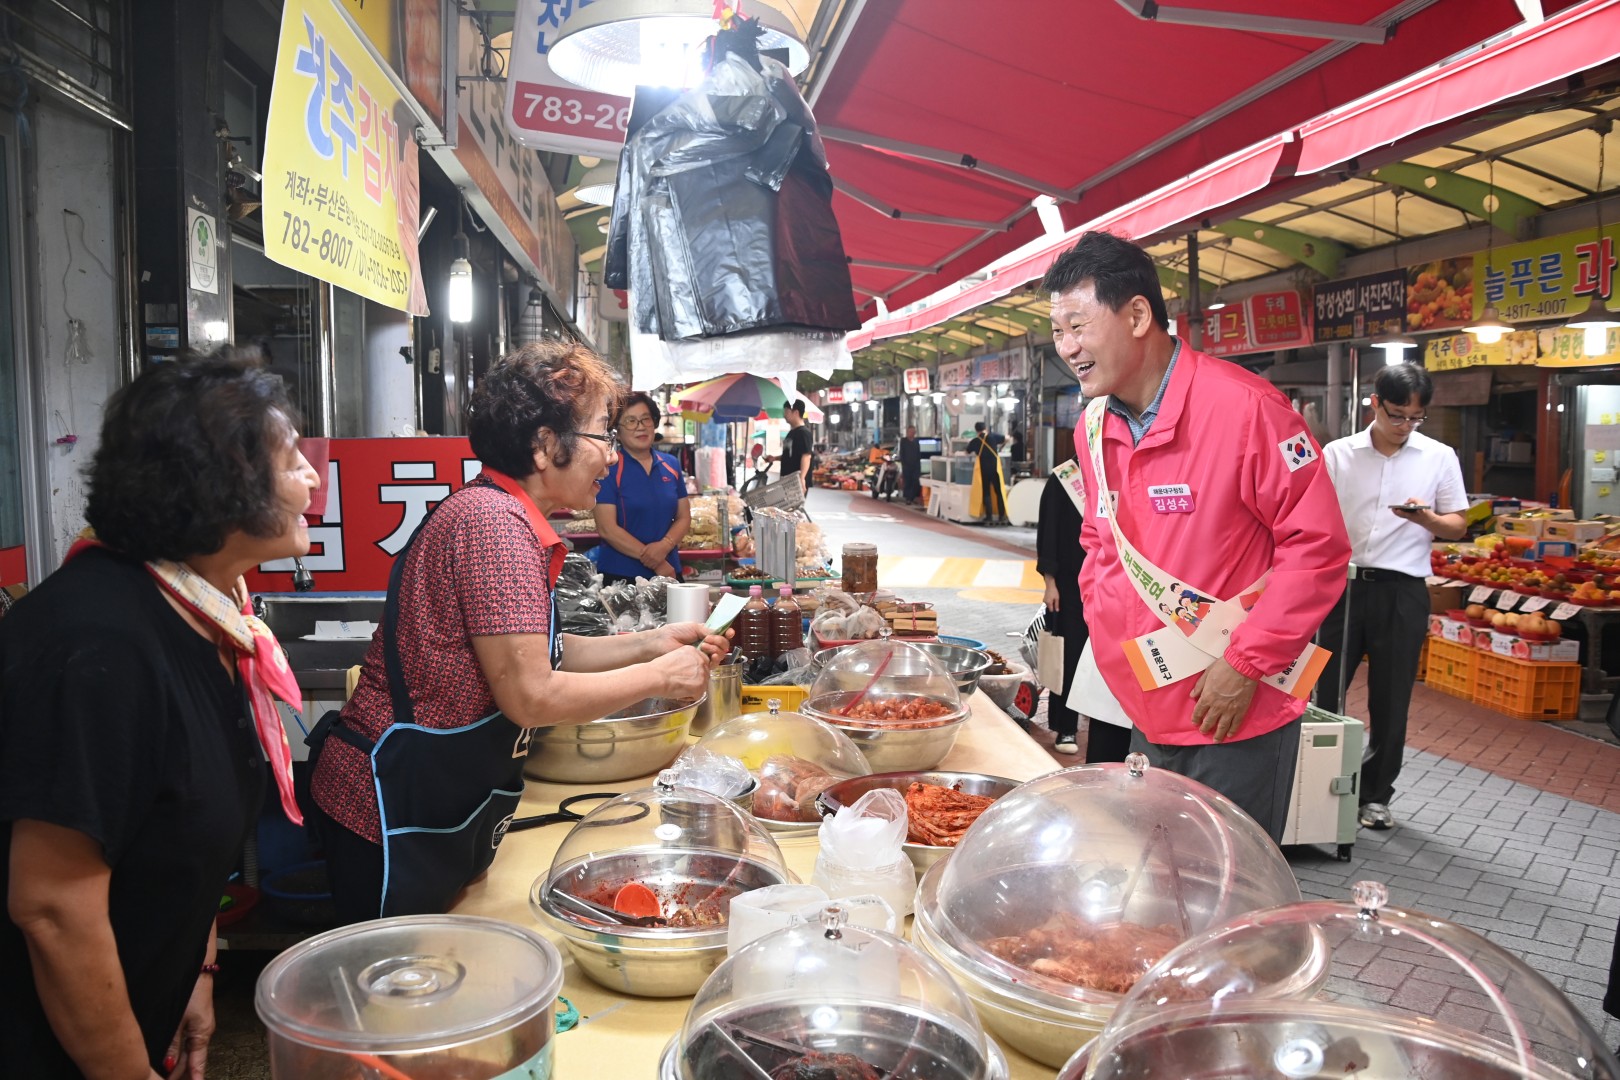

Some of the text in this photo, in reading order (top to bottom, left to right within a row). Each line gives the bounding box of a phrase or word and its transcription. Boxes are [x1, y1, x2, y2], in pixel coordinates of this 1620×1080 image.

[282, 210, 354, 270] 782-8007
[1484, 237, 1616, 303] 늘푸른 과
[1359, 280, 1405, 313] 서진전자
[1155, 498, 1189, 511] 김성수
[1123, 549, 1166, 601] 보내세요
[1151, 647, 1173, 681] 해운대구
